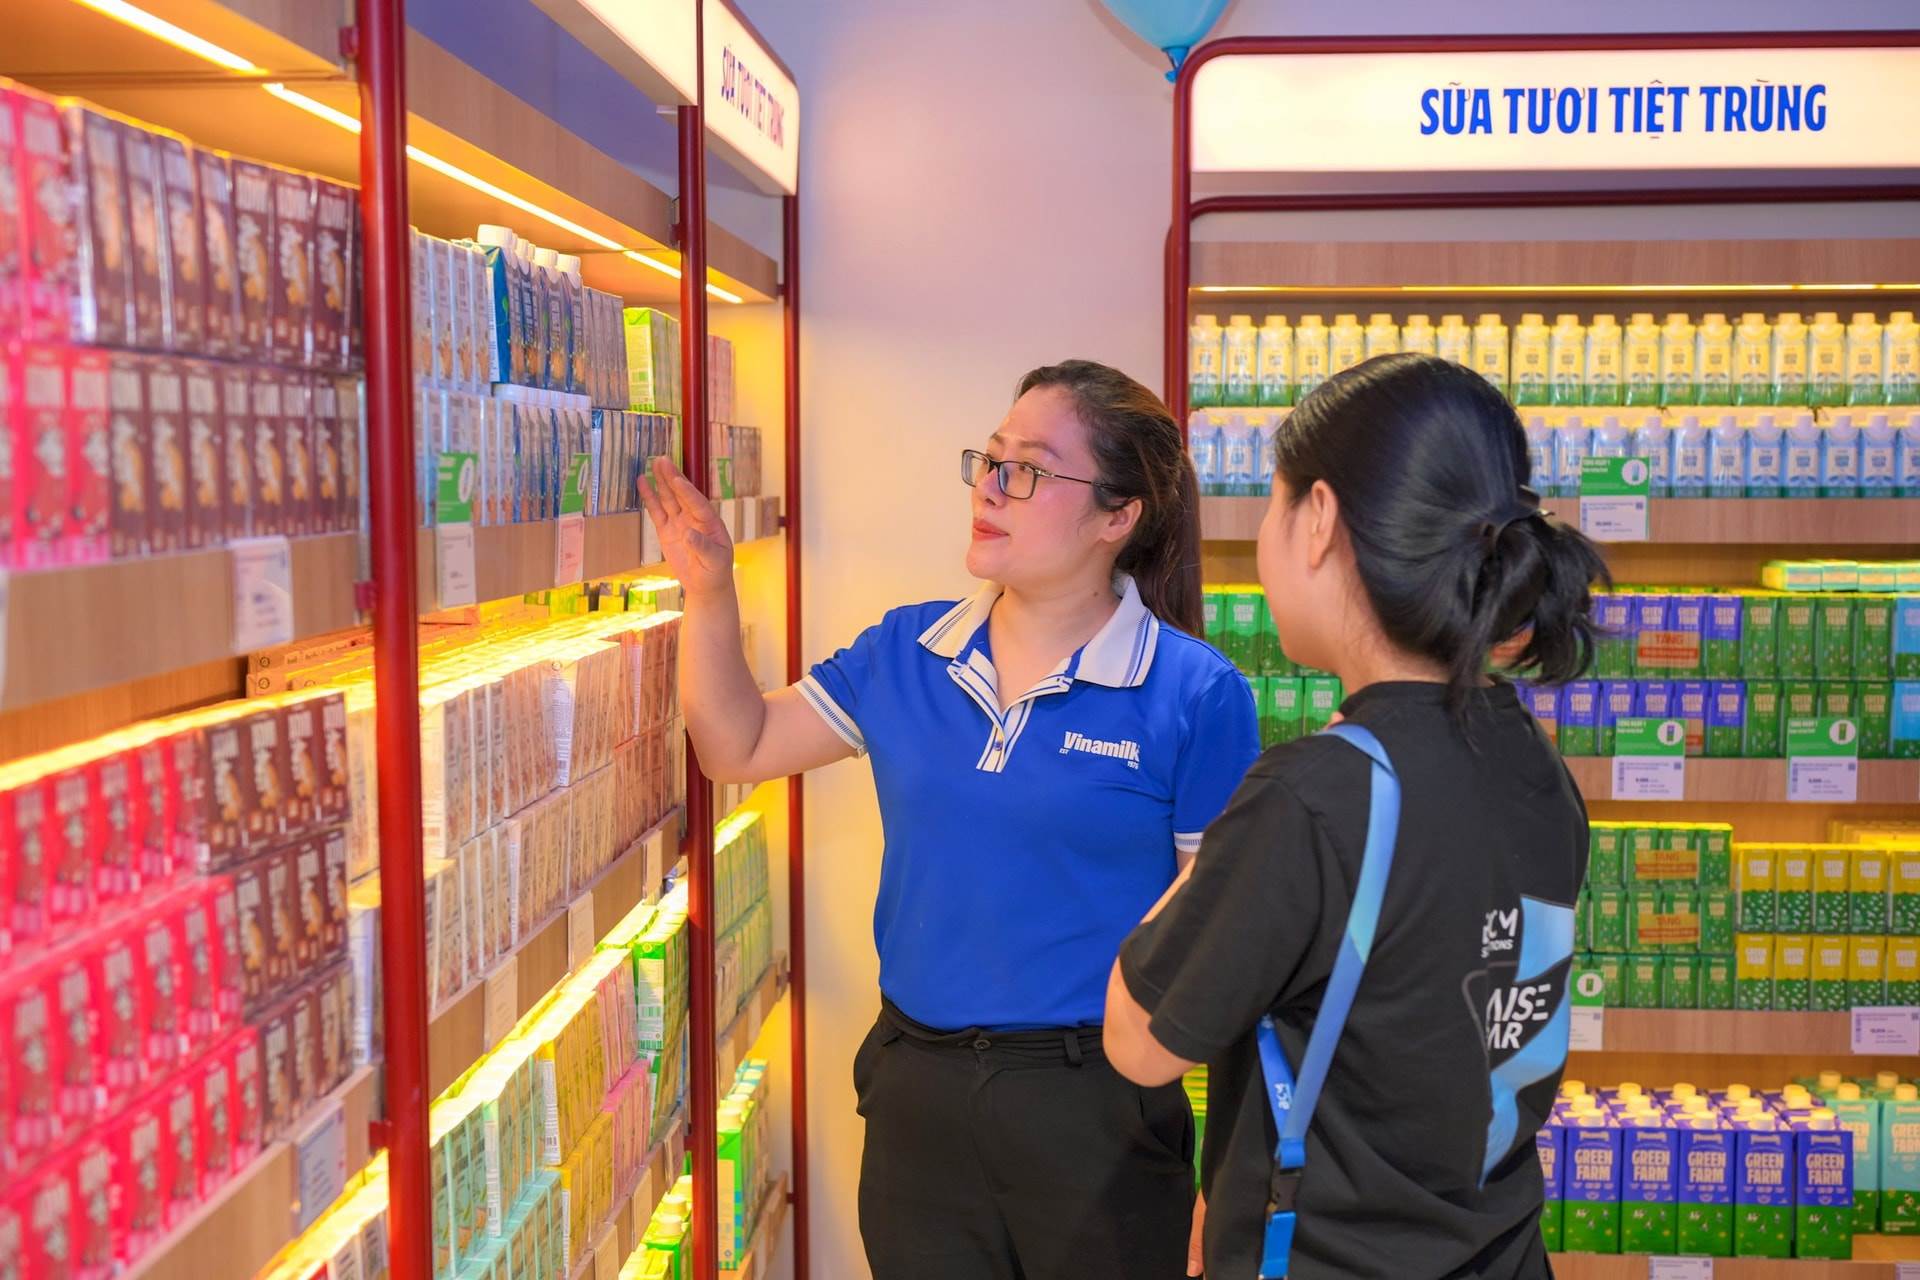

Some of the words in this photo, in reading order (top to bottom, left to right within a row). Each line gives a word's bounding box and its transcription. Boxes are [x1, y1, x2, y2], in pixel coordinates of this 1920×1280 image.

[1420, 82, 1493, 135] SỮA
[1503, 87, 1598, 134] TƯƠI
[1609, 79, 1690, 139] TIỆT
[1700, 78, 1827, 132] TRÙNG
[1063, 731, 1140, 762] Vinamilk
[1574, 1149, 1613, 1165] GREEN
[1632, 1150, 1670, 1165] GREEN
[1688, 1151, 1726, 1167] GREEN
[1745, 1153, 1785, 1168] GREEN
[1806, 1153, 1845, 1169] GREEN
[1576, 1165, 1611, 1181] FARM
[1633, 1166, 1668, 1182] FARM
[1689, 1168, 1725, 1183] FARM
[1747, 1168, 1782, 1184] FARM
[1808, 1169, 1843, 1185] FARM
